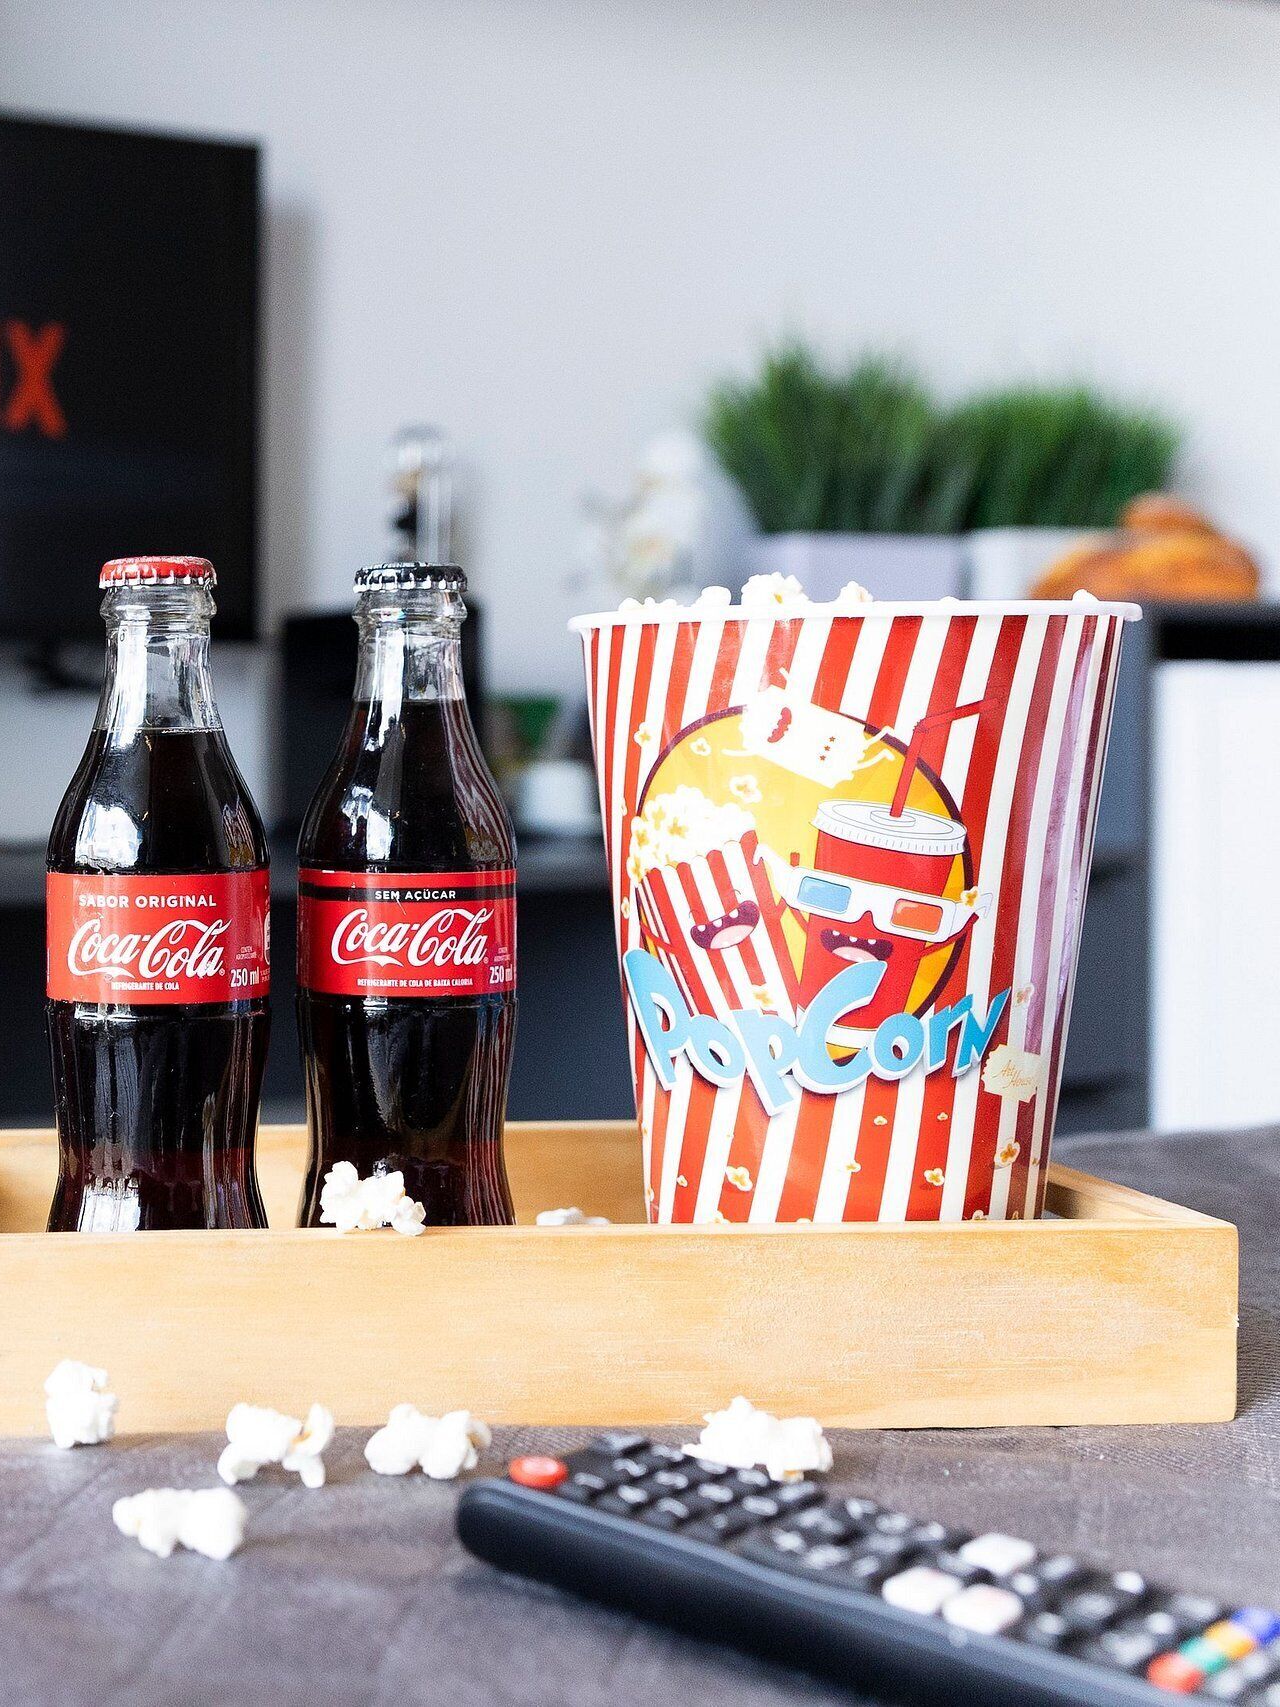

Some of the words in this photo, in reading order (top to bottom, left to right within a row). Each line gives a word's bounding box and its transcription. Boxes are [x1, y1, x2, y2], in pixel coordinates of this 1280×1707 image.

[78, 894, 129, 908] SABOR
[135, 894, 217, 908] ORIGINAL
[375, 890, 400, 901] SEM
[331, 908, 494, 967] Coca-Cola
[67, 918, 234, 979] Coca-Cola
[230, 967, 248, 988] 250
[249, 966, 260, 985] ml
[357, 978, 399, 987] REFRIGERANTE
[399, 979, 407, 987] DE
[408, 979, 423, 987] COLA
[424, 979, 432, 987] DE
[489, 965, 505, 984] 250
[155, 982, 163, 990] DE
[164, 981, 180, 991] COLA
